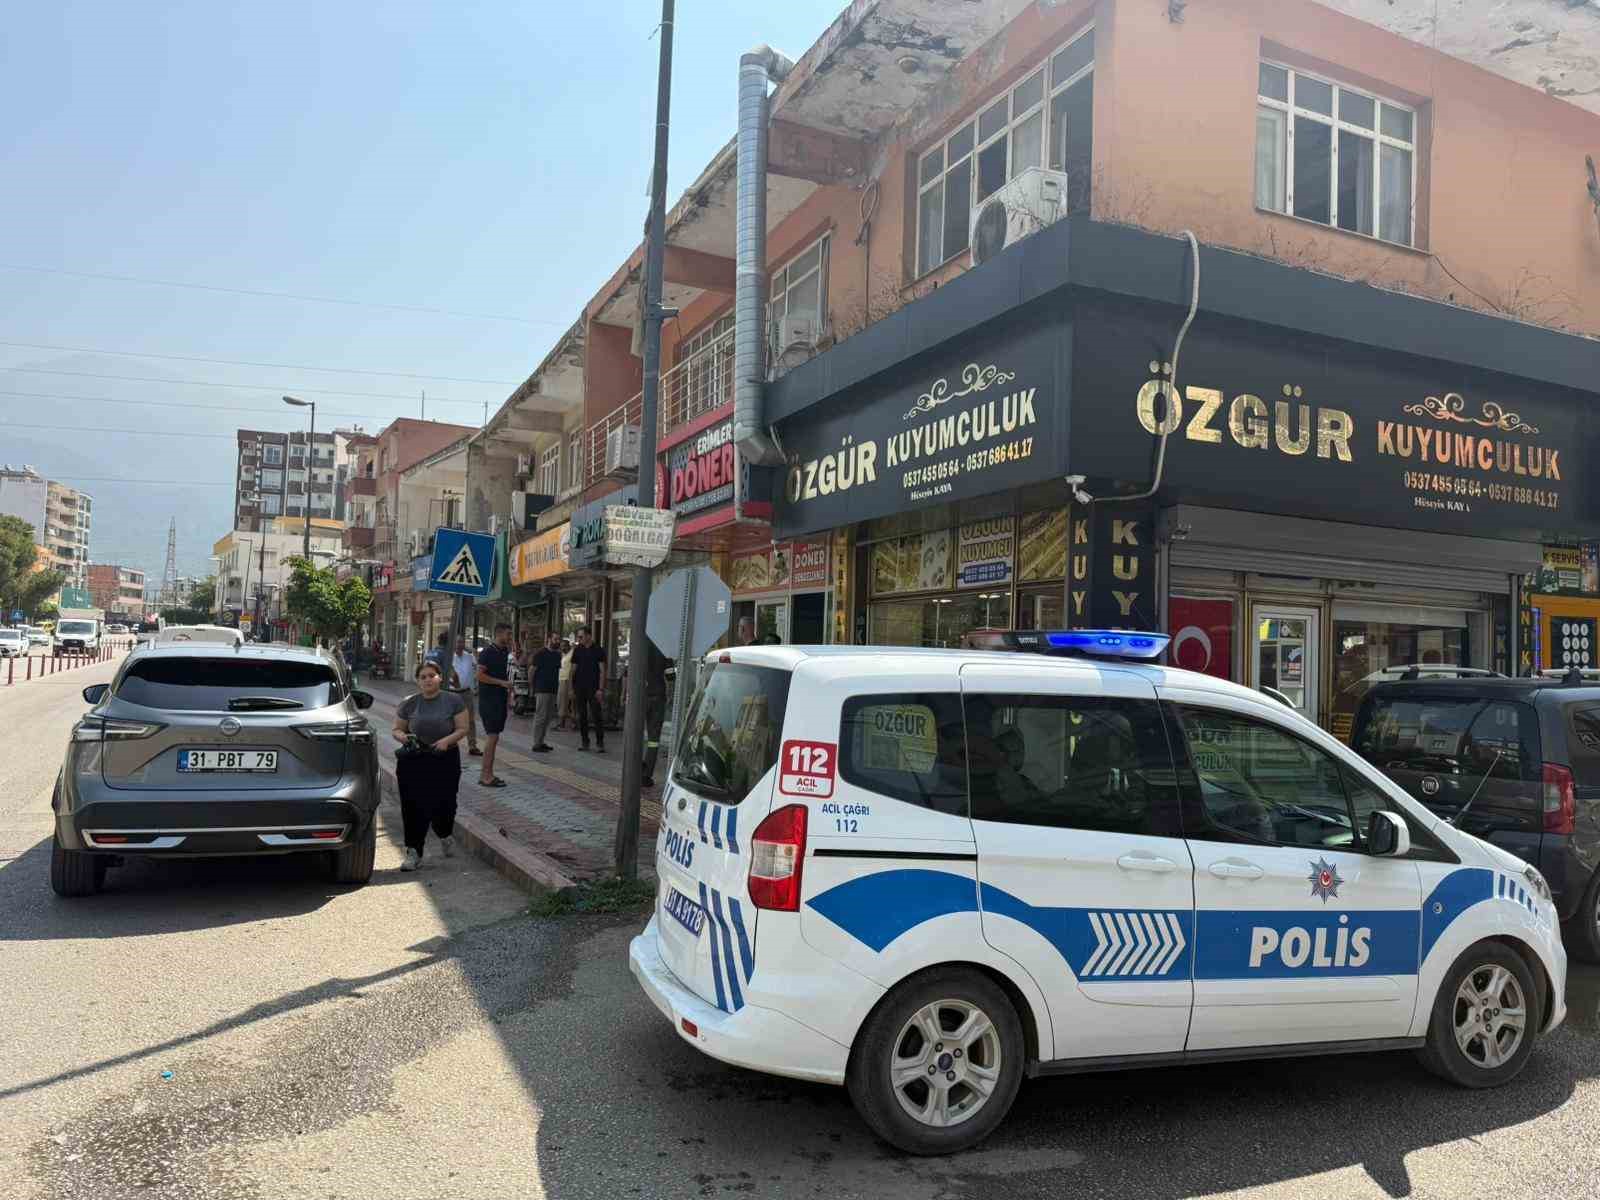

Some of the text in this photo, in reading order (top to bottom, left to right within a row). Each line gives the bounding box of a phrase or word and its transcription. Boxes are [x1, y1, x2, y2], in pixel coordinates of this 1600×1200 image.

[887, 388, 1036, 467] KUYUMCULUK
[1136, 361, 1354, 461] ÖZGÜR
[697, 422, 732, 455] ERİMLER
[966, 450, 988, 472] 0537
[988, 446, 1006, 466] 686
[1007, 441, 1020, 460] 41
[1021, 437, 1033, 457] 17
[1377, 421, 1561, 480] KUYUMCULUK
[674, 443, 735, 502] DÖNER
[788, 435, 878, 503] ÖZGÜR
[1404, 471, 1431, 490] 0537
[1488, 482, 1512, 502] 0537
[1072, 519, 1088, 629] KUY
[1112, 519, 1140, 630] KUY
[190, 752, 274, 767] 31 PBT 79
[790, 746, 829, 774] 112
[836, 819, 858, 833] 112
[843, 802, 870, 817] ÇAĞRI
[665, 828, 696, 869] POLİS
[681, 900, 703, 932] 9178
[1249, 914, 1372, 968] POLİS
